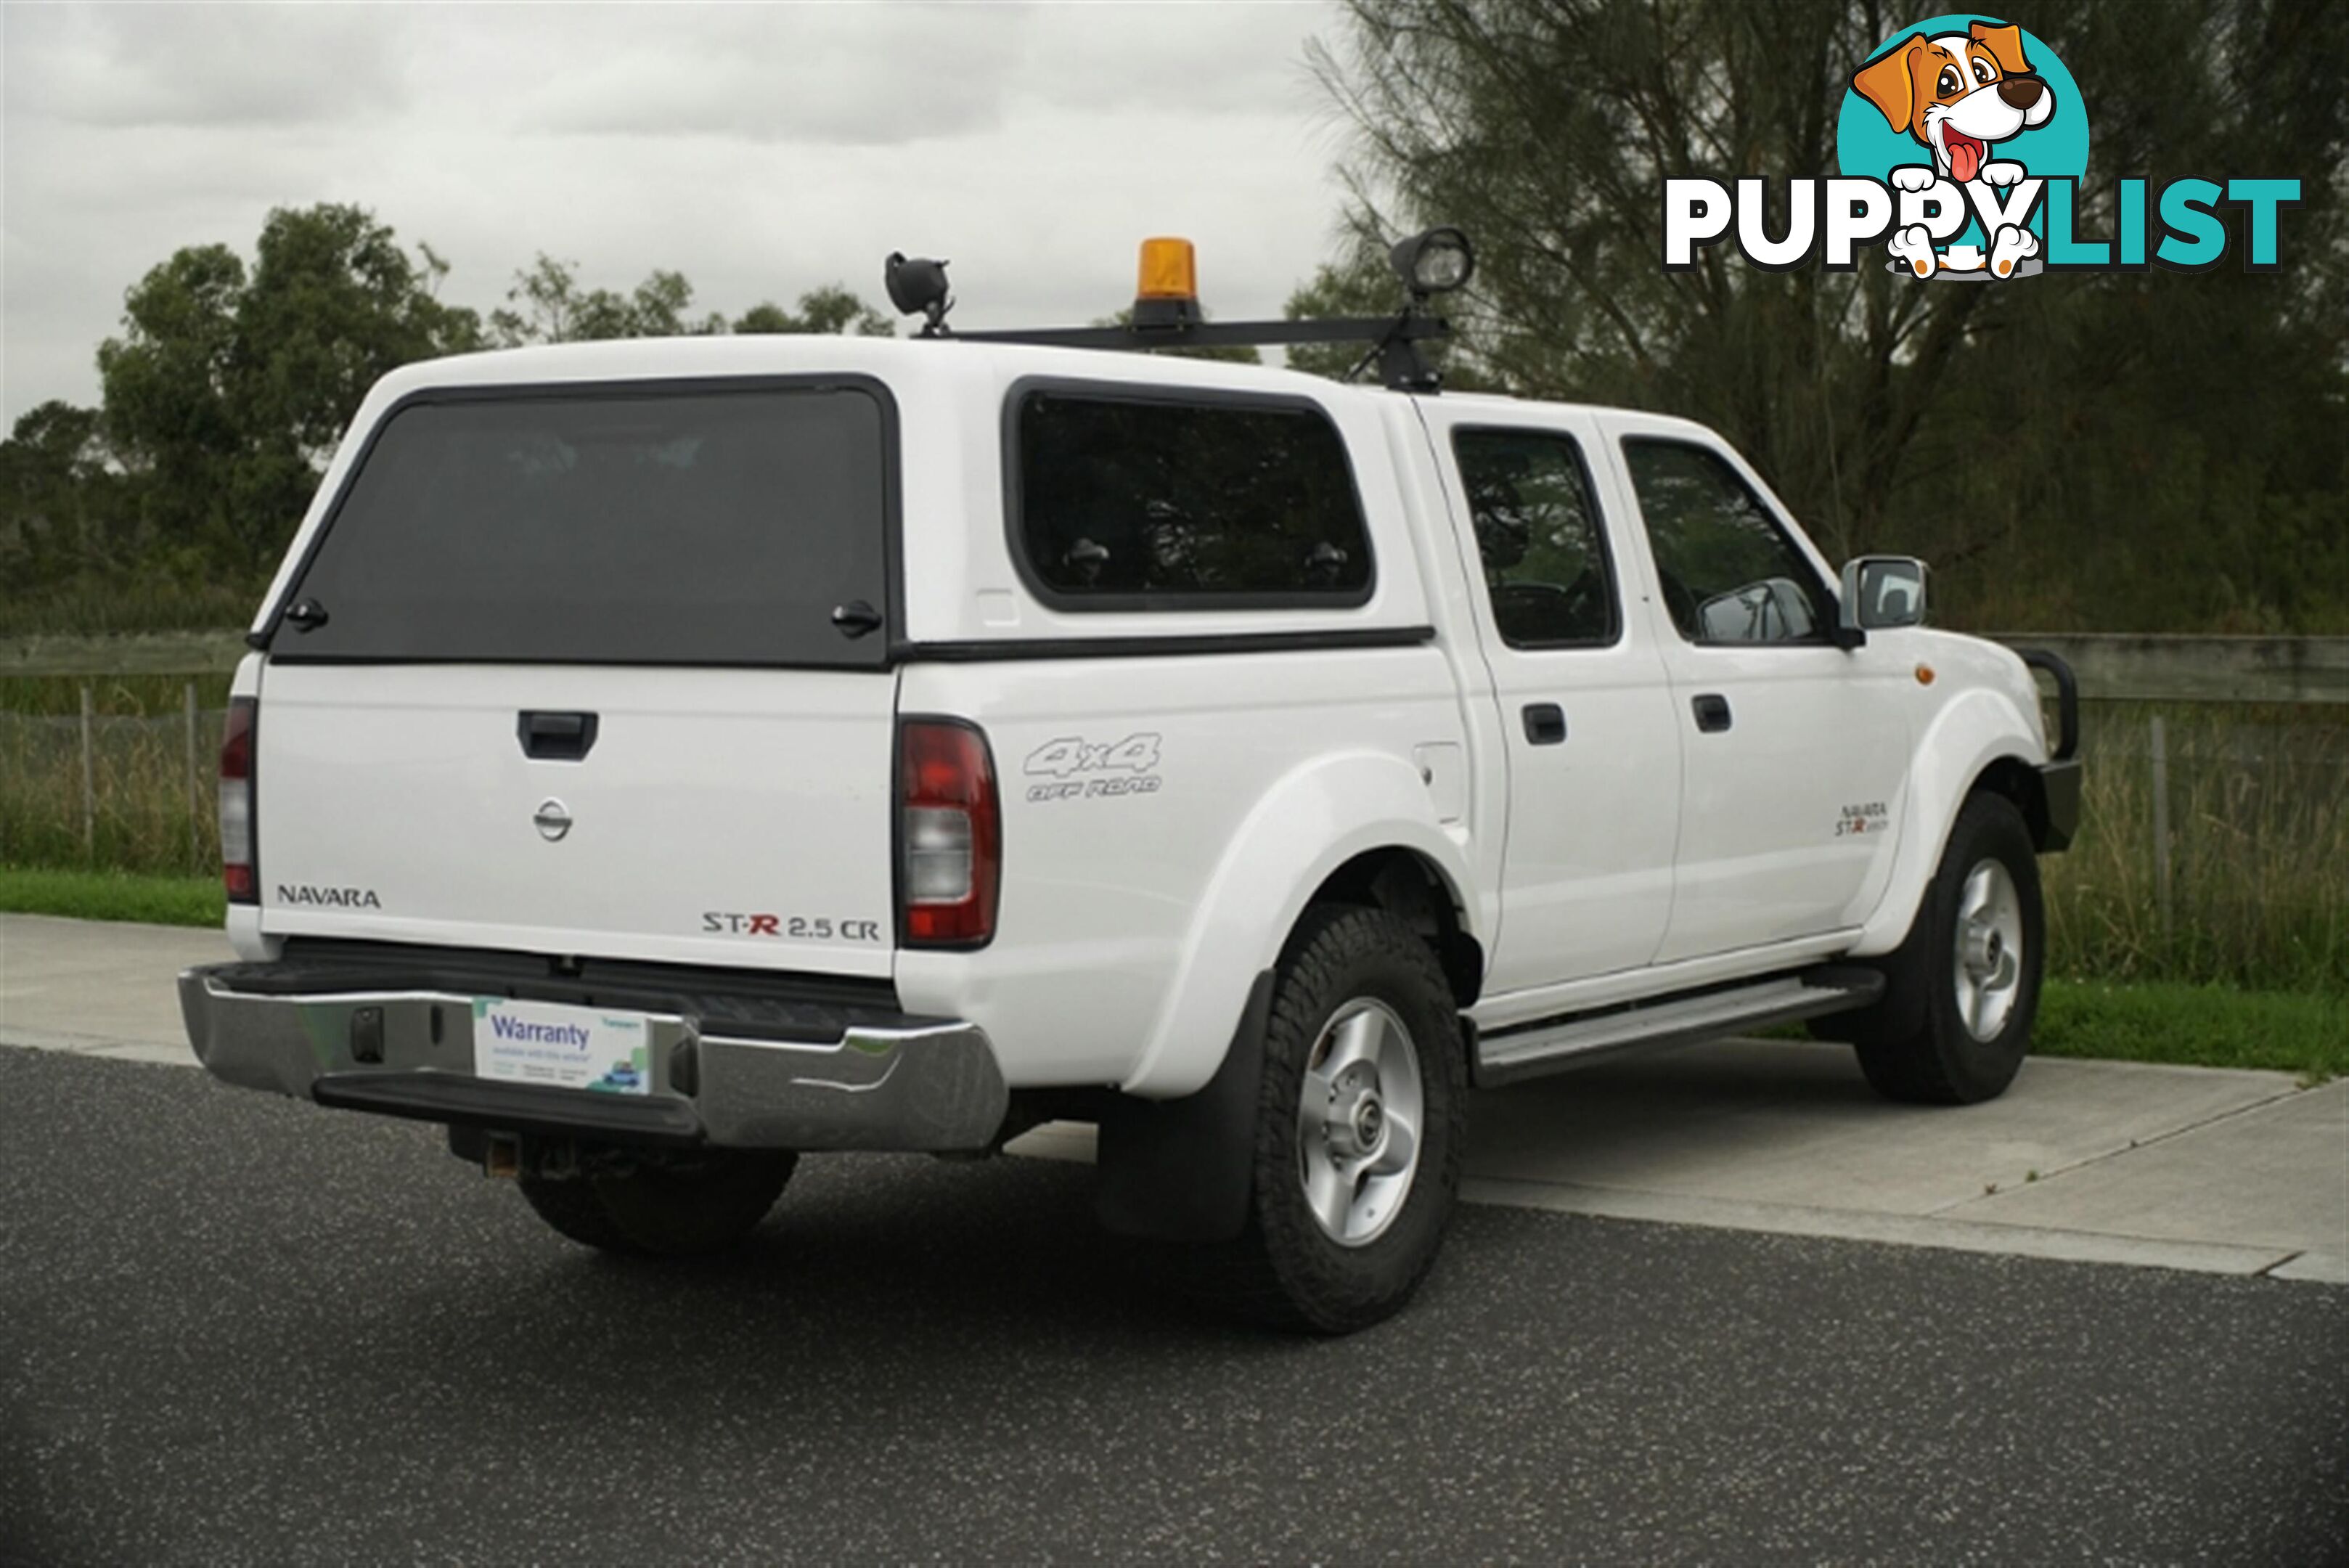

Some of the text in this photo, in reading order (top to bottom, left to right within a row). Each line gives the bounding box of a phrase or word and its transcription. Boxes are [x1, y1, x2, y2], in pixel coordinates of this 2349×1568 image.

[1023, 732, 1162, 779] 4x4
[1026, 775, 1162, 801] OFF ROAD
[278, 884, 382, 909] NAVARA
[788, 917, 833, 939] 2.5
[839, 920, 880, 942] CR
[491, 1014, 589, 1051] Warranty
